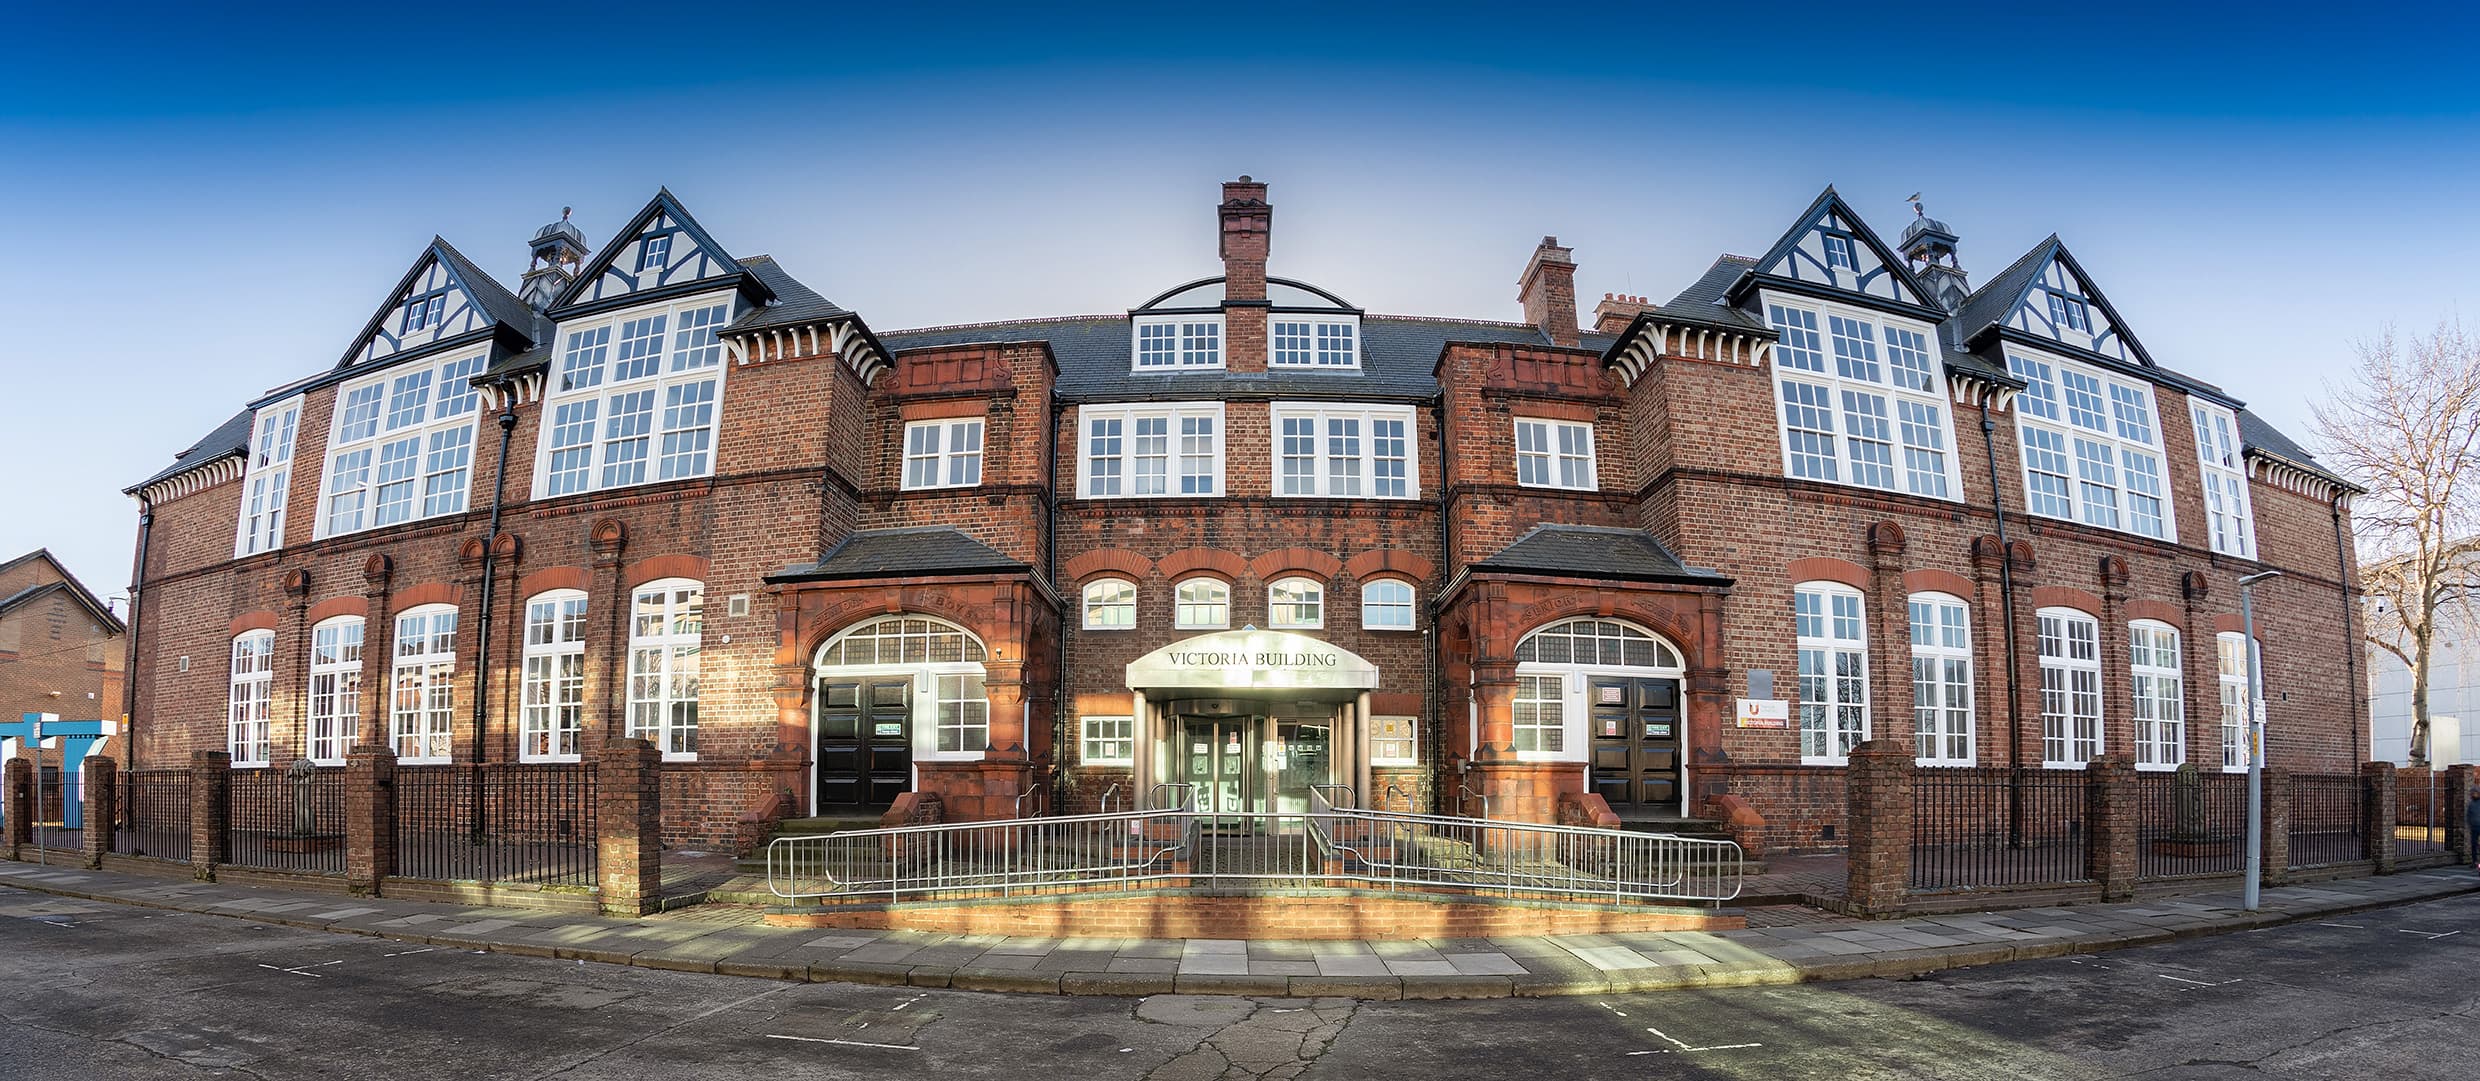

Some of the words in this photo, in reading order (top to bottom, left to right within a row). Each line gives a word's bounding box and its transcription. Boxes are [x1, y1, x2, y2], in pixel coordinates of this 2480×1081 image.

[1526, 596, 1572, 618] SENIOR
[1168, 652, 1249, 666] VICTORIA
[1255, 652, 1337, 667] BUILDING
